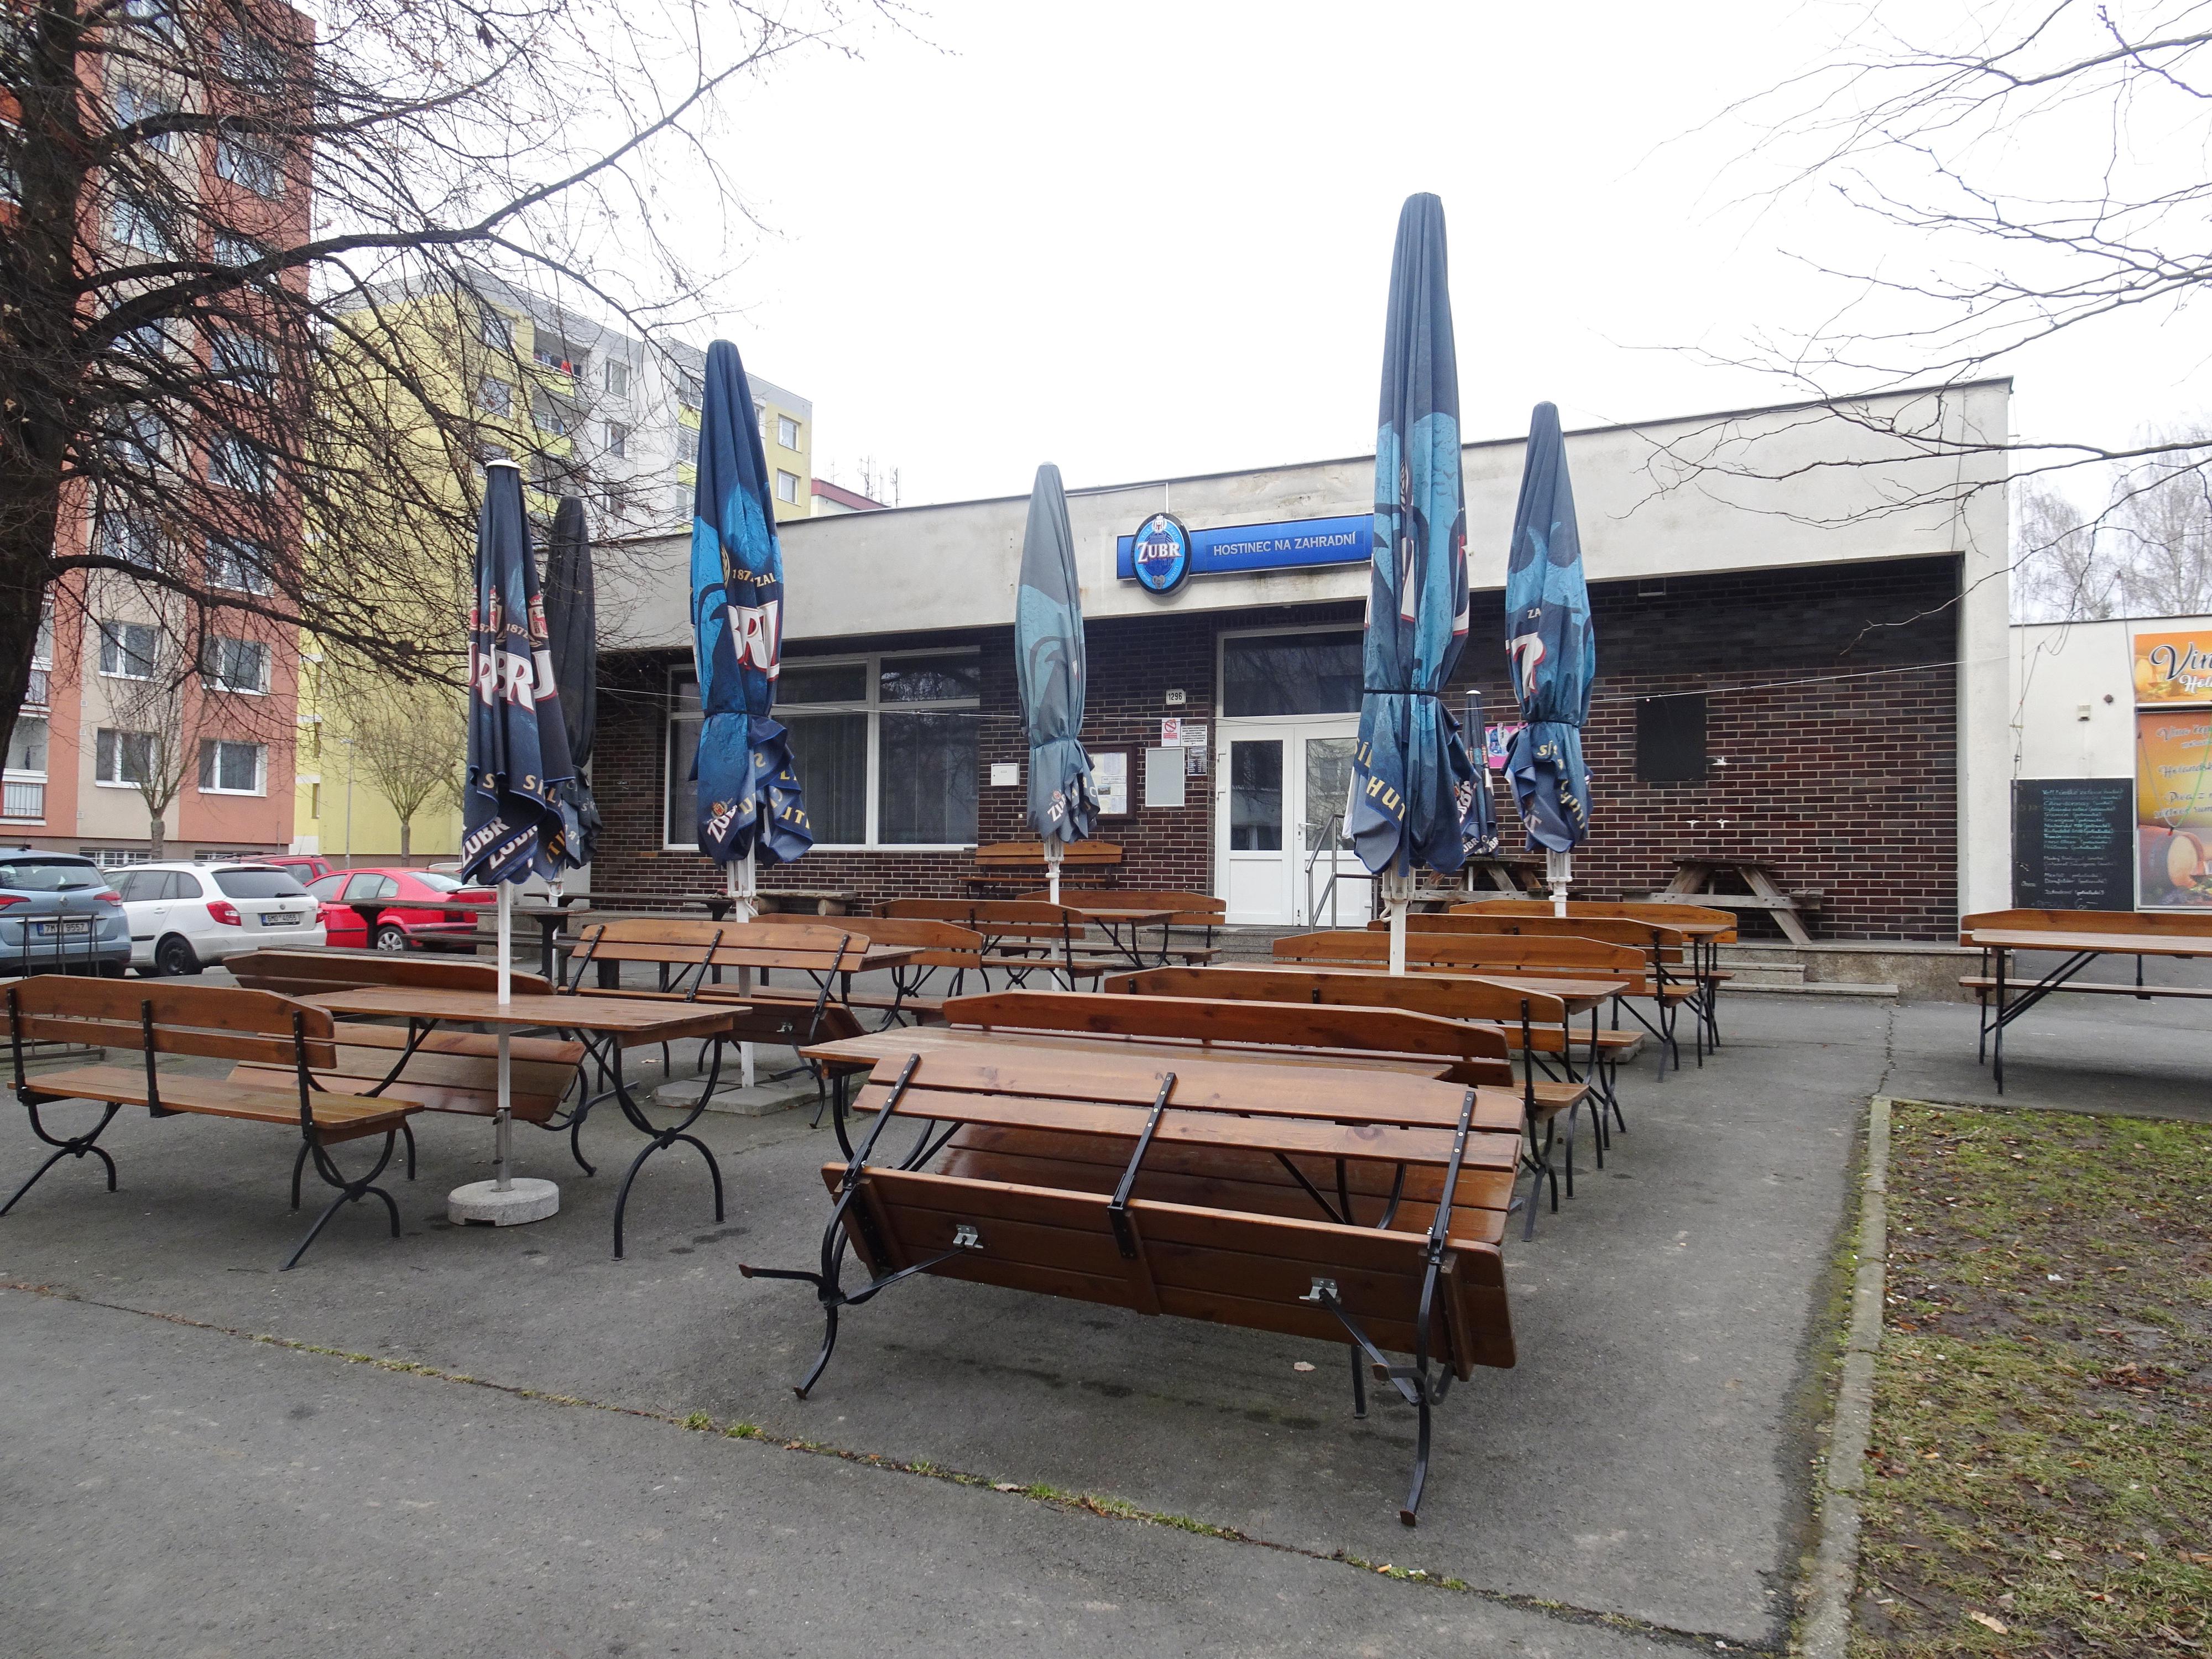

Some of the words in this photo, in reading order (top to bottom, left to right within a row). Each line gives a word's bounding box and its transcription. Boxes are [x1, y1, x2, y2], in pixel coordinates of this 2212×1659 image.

[1137, 541, 1183, 564] ZUBR
[1214, 541, 1271, 556] HOSTINEC
[1275, 539, 1292, 551] NA
[1295, 531, 1355, 549] ZAHRADNÍ
[2149, 641, 2212, 681] Vin
[1168, 692, 1182, 701] 1296
